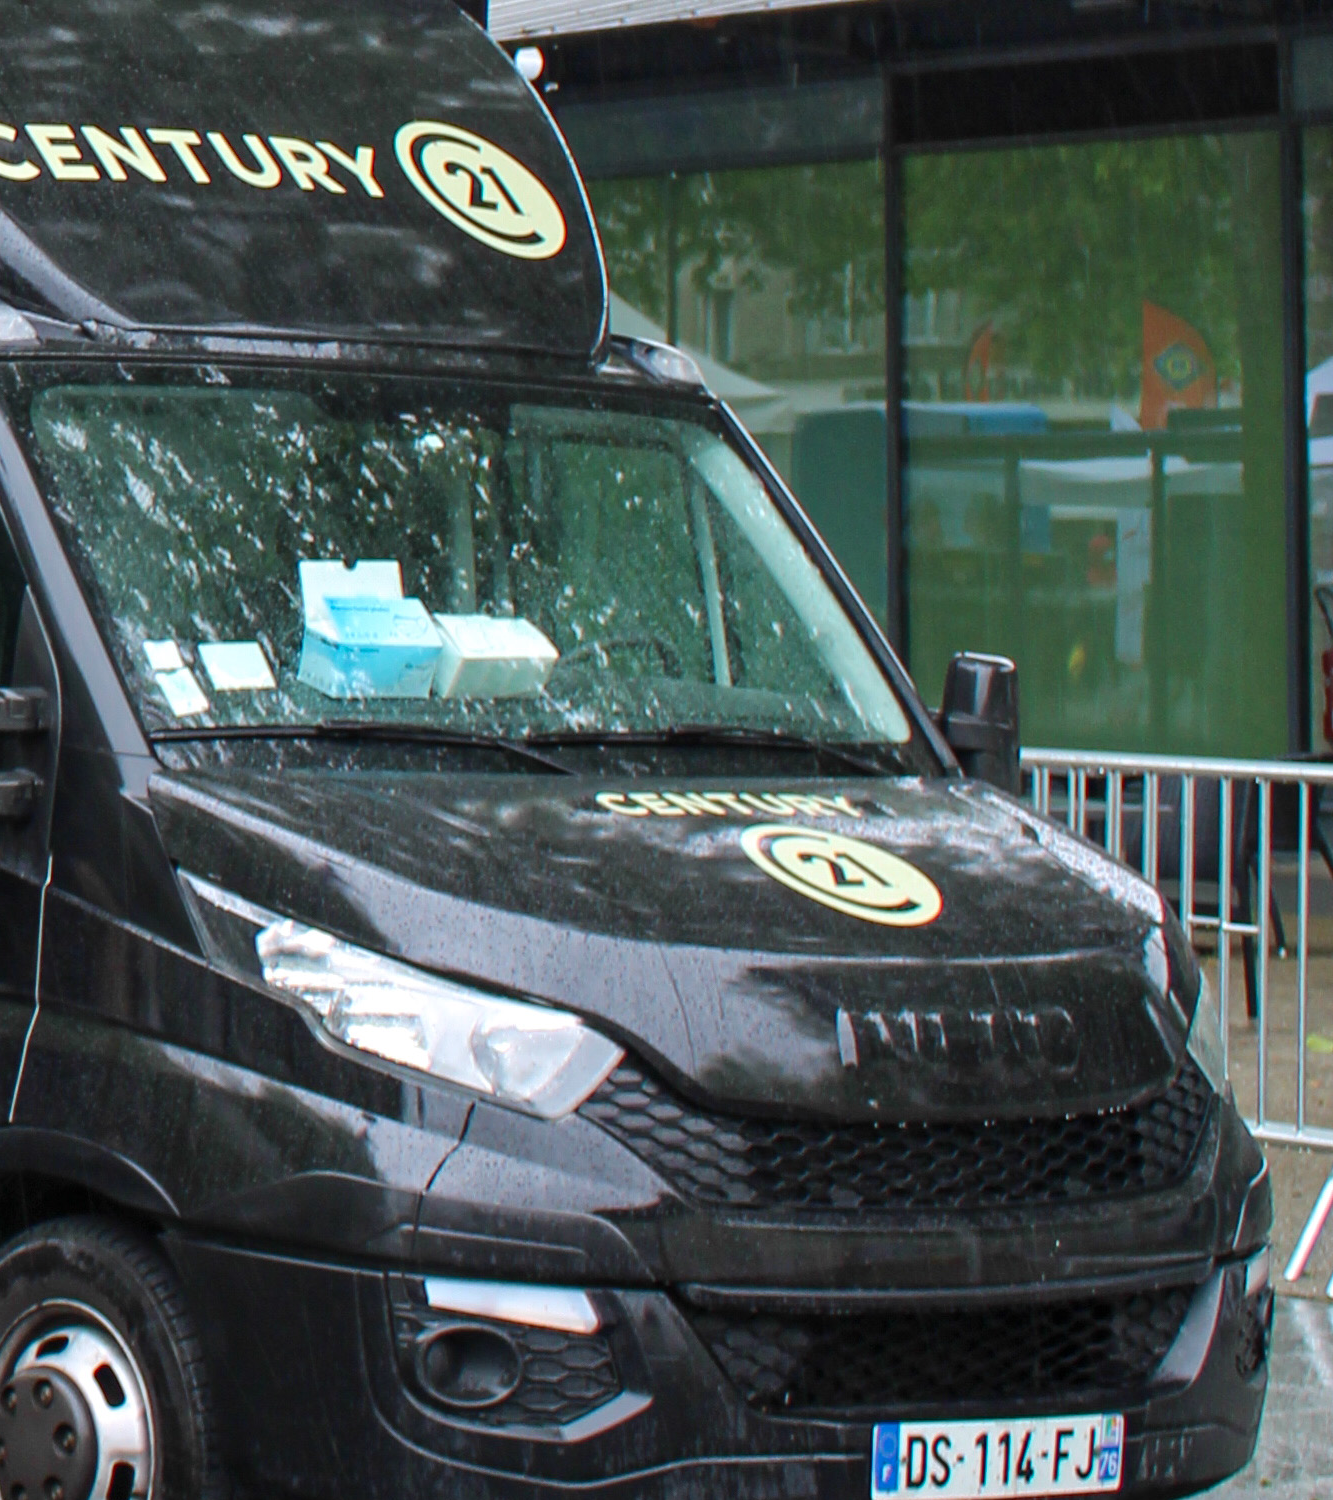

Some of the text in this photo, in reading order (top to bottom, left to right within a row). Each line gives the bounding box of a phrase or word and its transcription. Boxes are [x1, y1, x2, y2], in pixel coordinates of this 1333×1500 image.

[444, 160, 529, 217] 21
[595, 790, 864, 818] CENTURY
[797, 851, 894, 888] 21
[906, 1426, 1096, 1489] DS-114-FJ
[1100, 1456, 1119, 1476] 76
